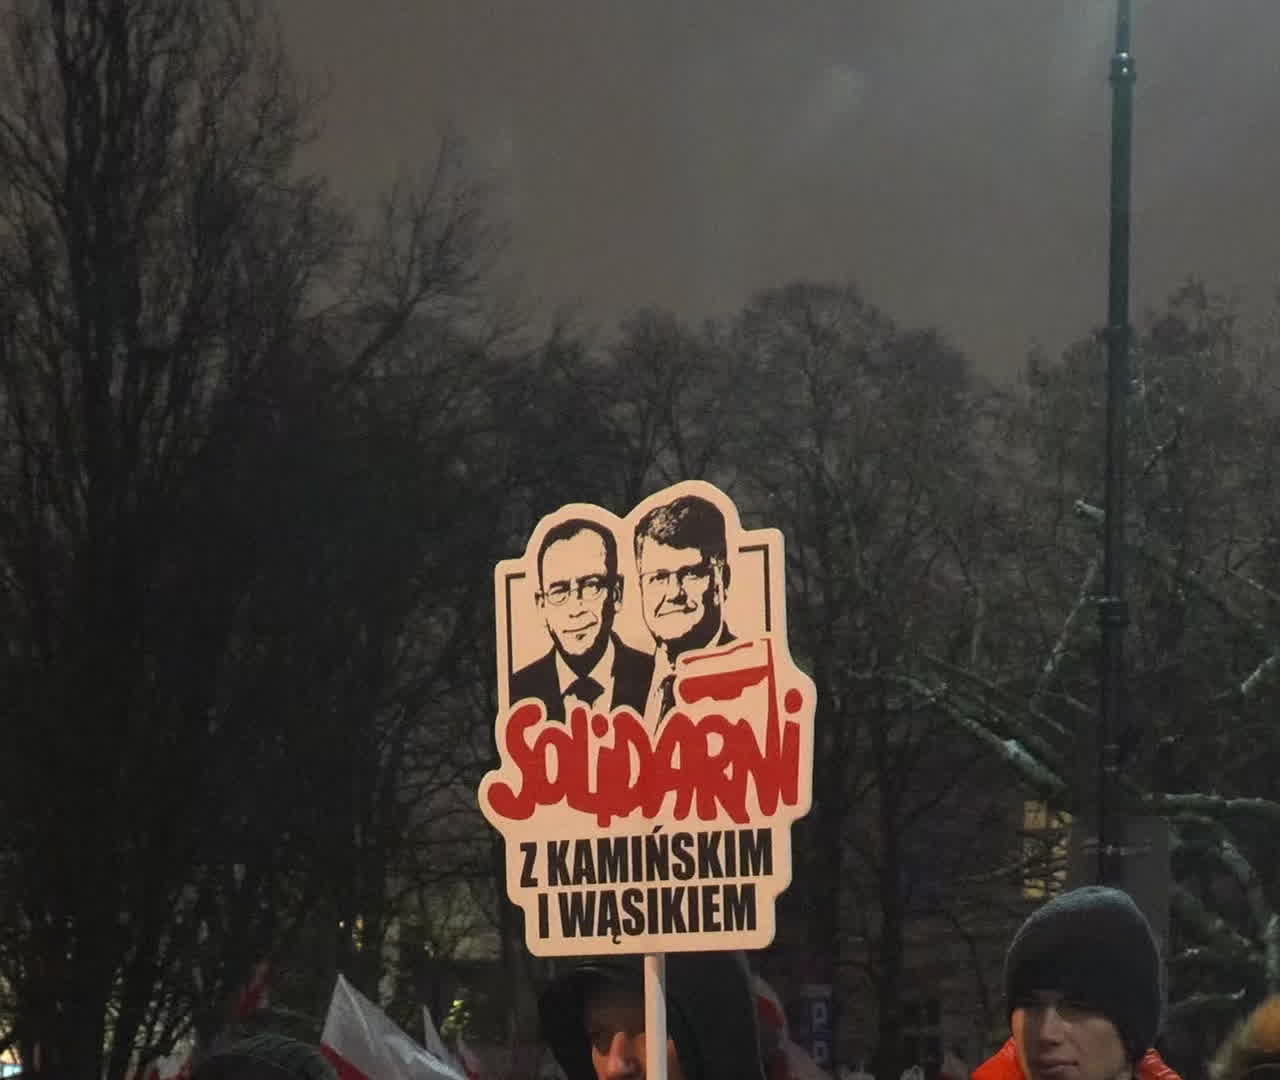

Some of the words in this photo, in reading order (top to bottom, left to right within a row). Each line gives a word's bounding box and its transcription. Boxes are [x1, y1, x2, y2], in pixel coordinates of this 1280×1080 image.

[519, 842, 538, 888] Z
[547, 825, 773, 887] KAMIŃSKIM
[538, 893, 550, 939] I
[557, 883, 757, 945] WĄSIKIEM
